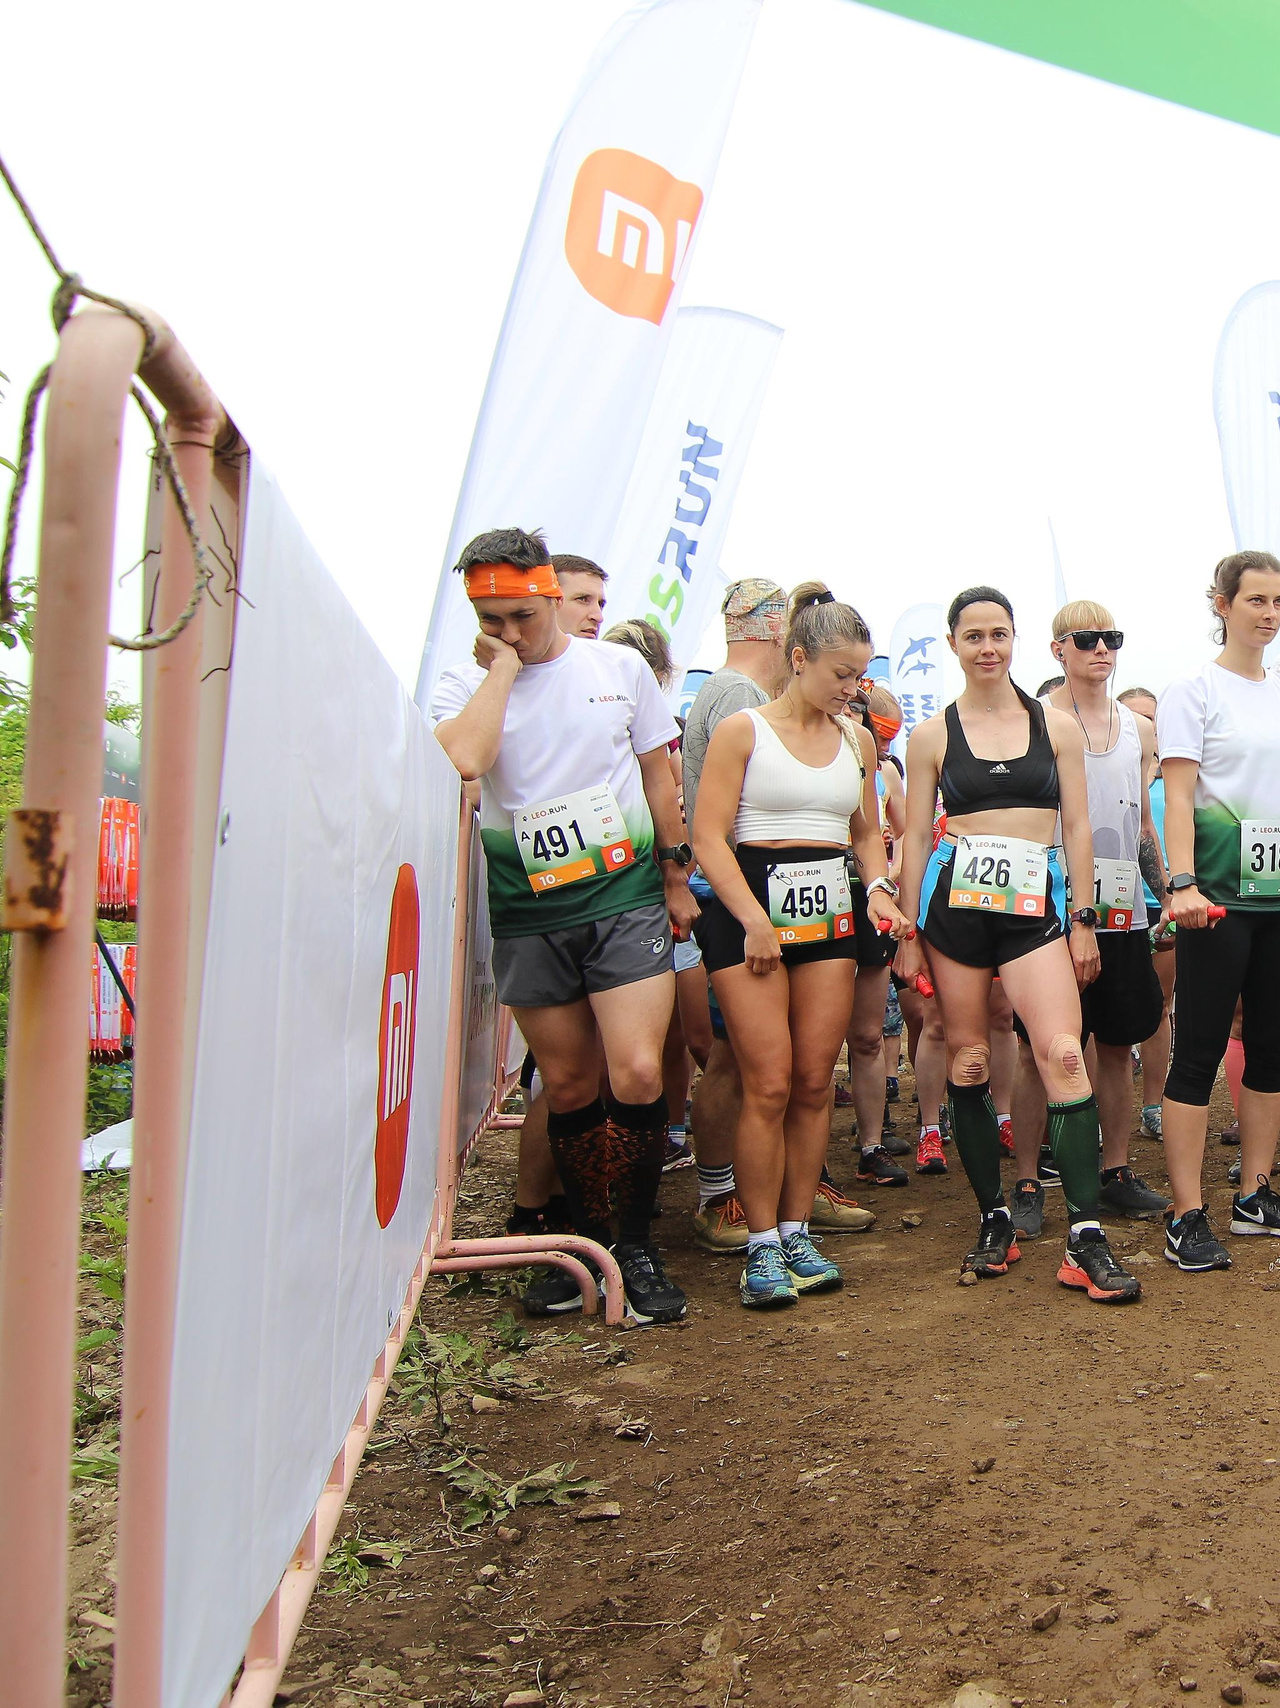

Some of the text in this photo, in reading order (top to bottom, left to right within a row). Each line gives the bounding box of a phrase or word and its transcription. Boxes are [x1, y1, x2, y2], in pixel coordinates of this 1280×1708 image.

[530, 803, 568, 820] LEO.RUN
[520, 819, 587, 862] A 491
[975, 841, 1007, 849] LEO.RUN
[789, 868, 821, 878] LEO.RUN
[962, 856, 1011, 888] 426
[539, 873, 556, 887] 10
[1248, 883, 1255, 893] 5
[781, 884, 828, 919] 459
[958, 893, 971, 904] 10
[981, 896, 990, 905] A
[780, 930, 796, 941] 10
